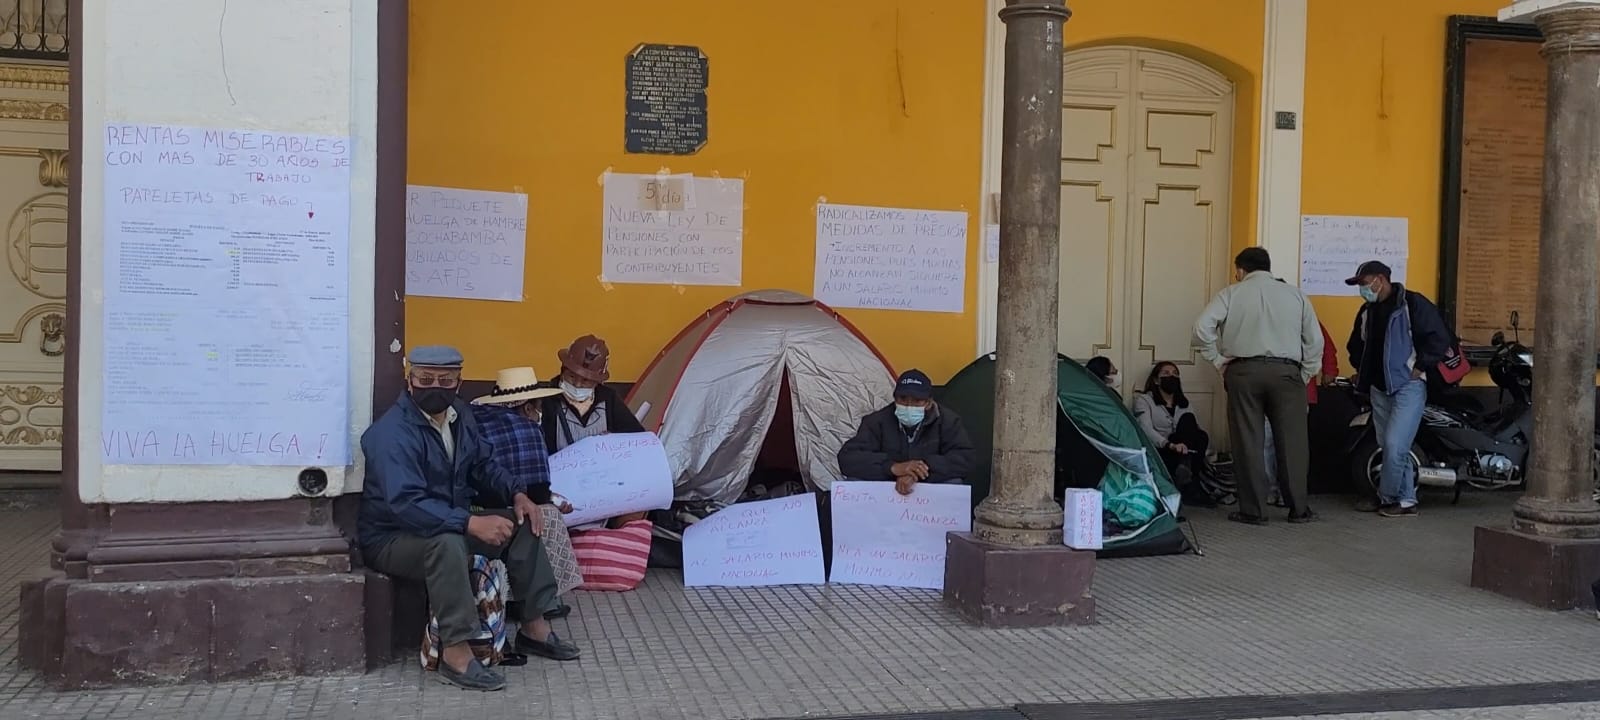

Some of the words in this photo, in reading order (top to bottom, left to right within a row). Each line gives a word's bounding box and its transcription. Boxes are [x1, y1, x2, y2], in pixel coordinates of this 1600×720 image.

[107, 126, 191, 146] RENTAS
[203, 130, 346, 155] MISERABLES
[106, 151, 143, 166] CON
[158, 151, 195, 165] MAS
[215, 152, 237, 166] DE
[248, 154, 269, 167] 30
[333, 157, 350, 168] DE
[246, 172, 312, 184] TRABAJO
[119, 187, 215, 204] PAPELETAS
[231, 193, 249, 205] DE
[431, 191, 504, 214] PIQUETE
[609, 204, 656, 223] NUEVA
[668, 212, 695, 228] LEY
[705, 211, 728, 226] DE
[817, 206, 905, 221] RADICALIZAMOS
[915, 212, 938, 223] LAS
[483, 216, 526, 232] HAMBRE
[821, 222, 883, 237] MEDIDAS
[892, 224, 905, 234] DE
[607, 226, 669, 242] PENSIONES
[678, 232, 700, 243] CON
[692, 246, 705, 256] DE
[908, 244, 916, 255] A
[490, 251, 513, 266] DE
[616, 262, 720, 274] CONTRIBUYENTES
[101, 430, 160, 458] VIVA
[173, 432, 196, 458] LA
[211, 431, 300, 457] HUELGA
